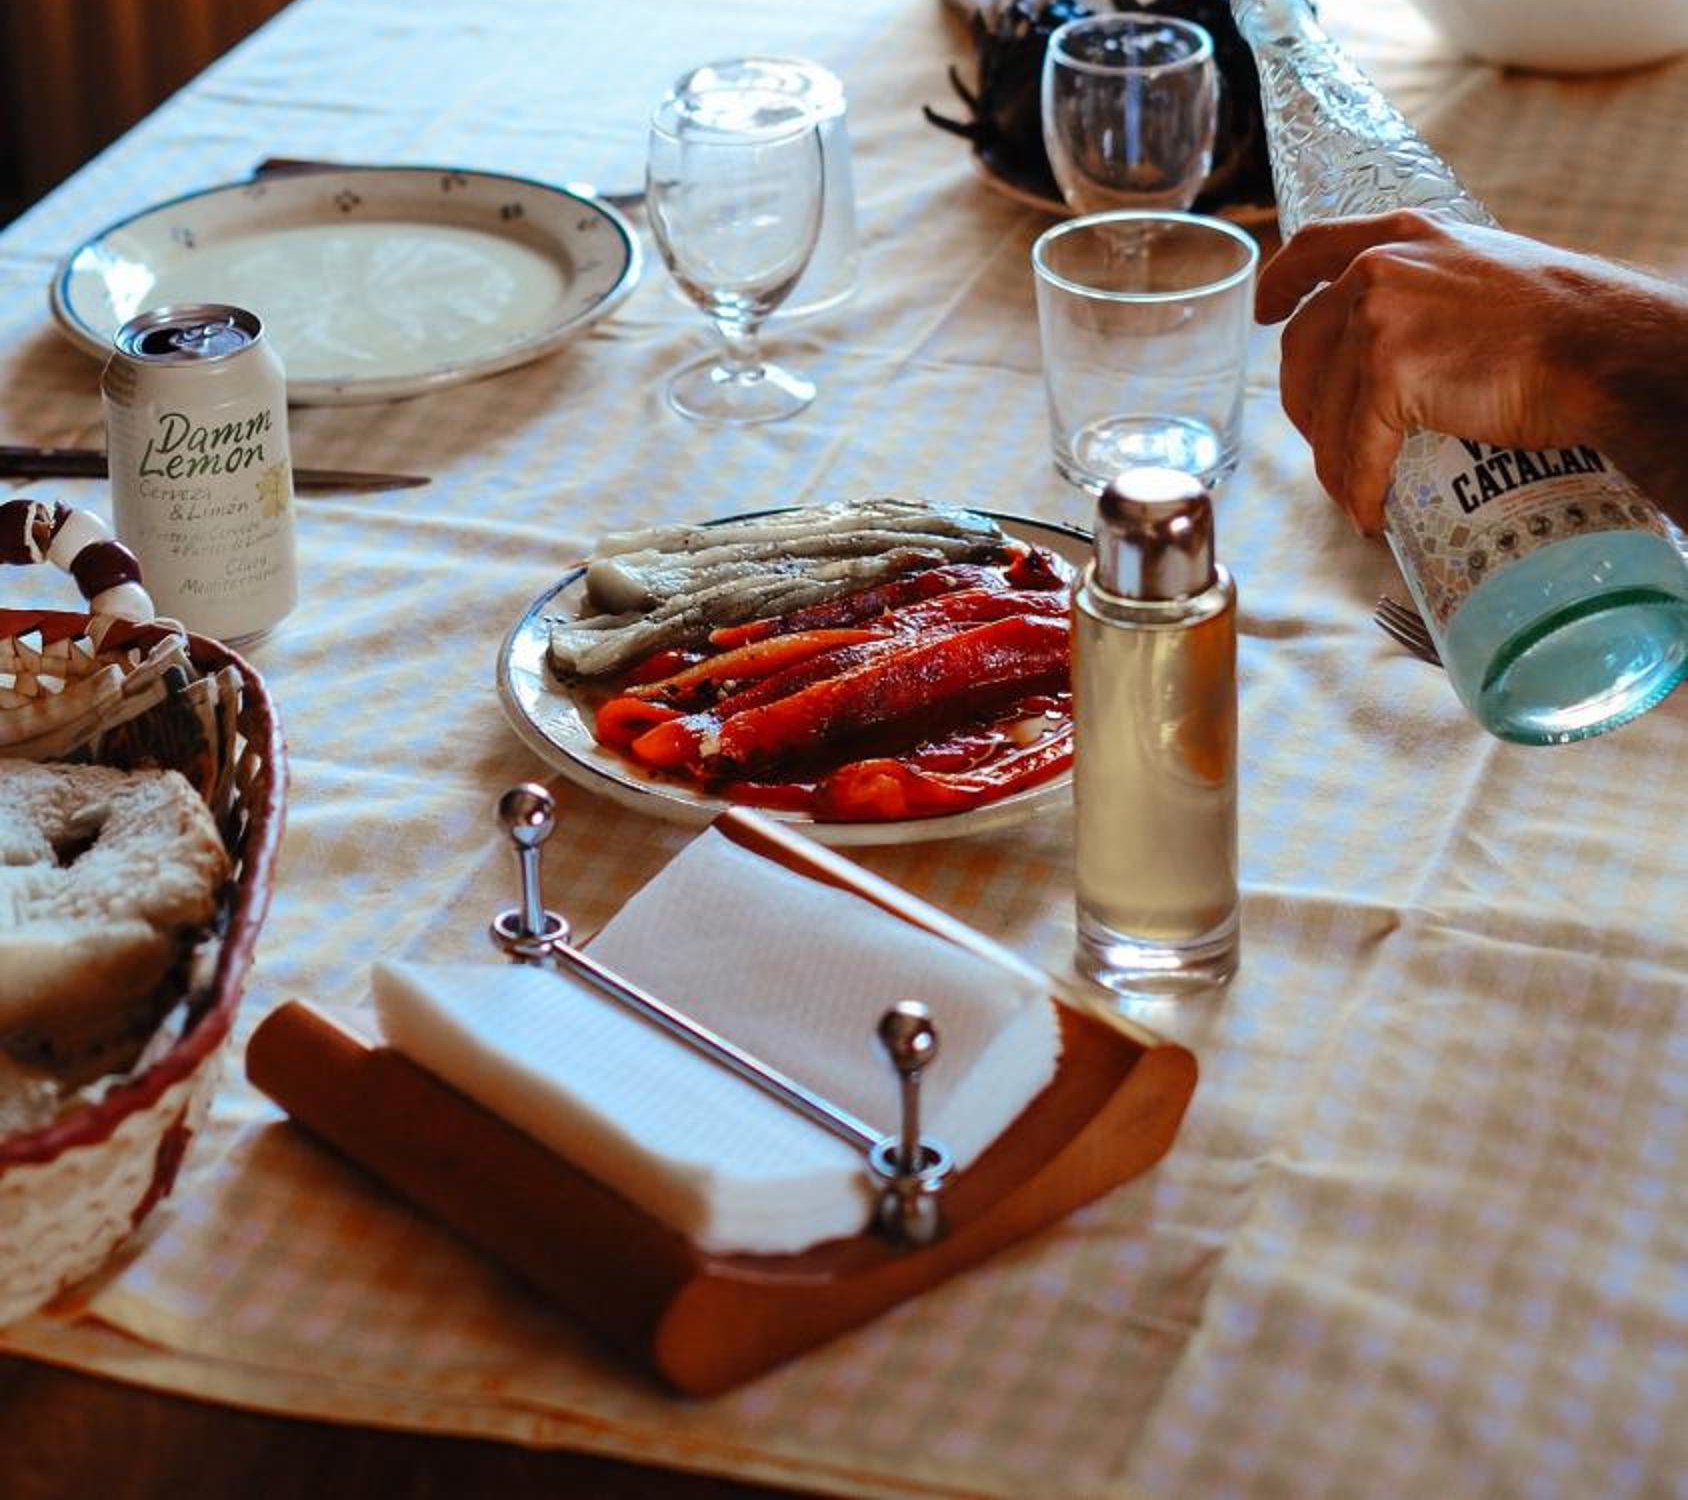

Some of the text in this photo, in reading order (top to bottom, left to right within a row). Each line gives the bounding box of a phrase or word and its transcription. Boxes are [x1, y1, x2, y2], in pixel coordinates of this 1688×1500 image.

[155, 410, 272, 454] Damm
[139, 438, 264, 479] Lemon
[1452, 444, 1606, 514] CATALAN
